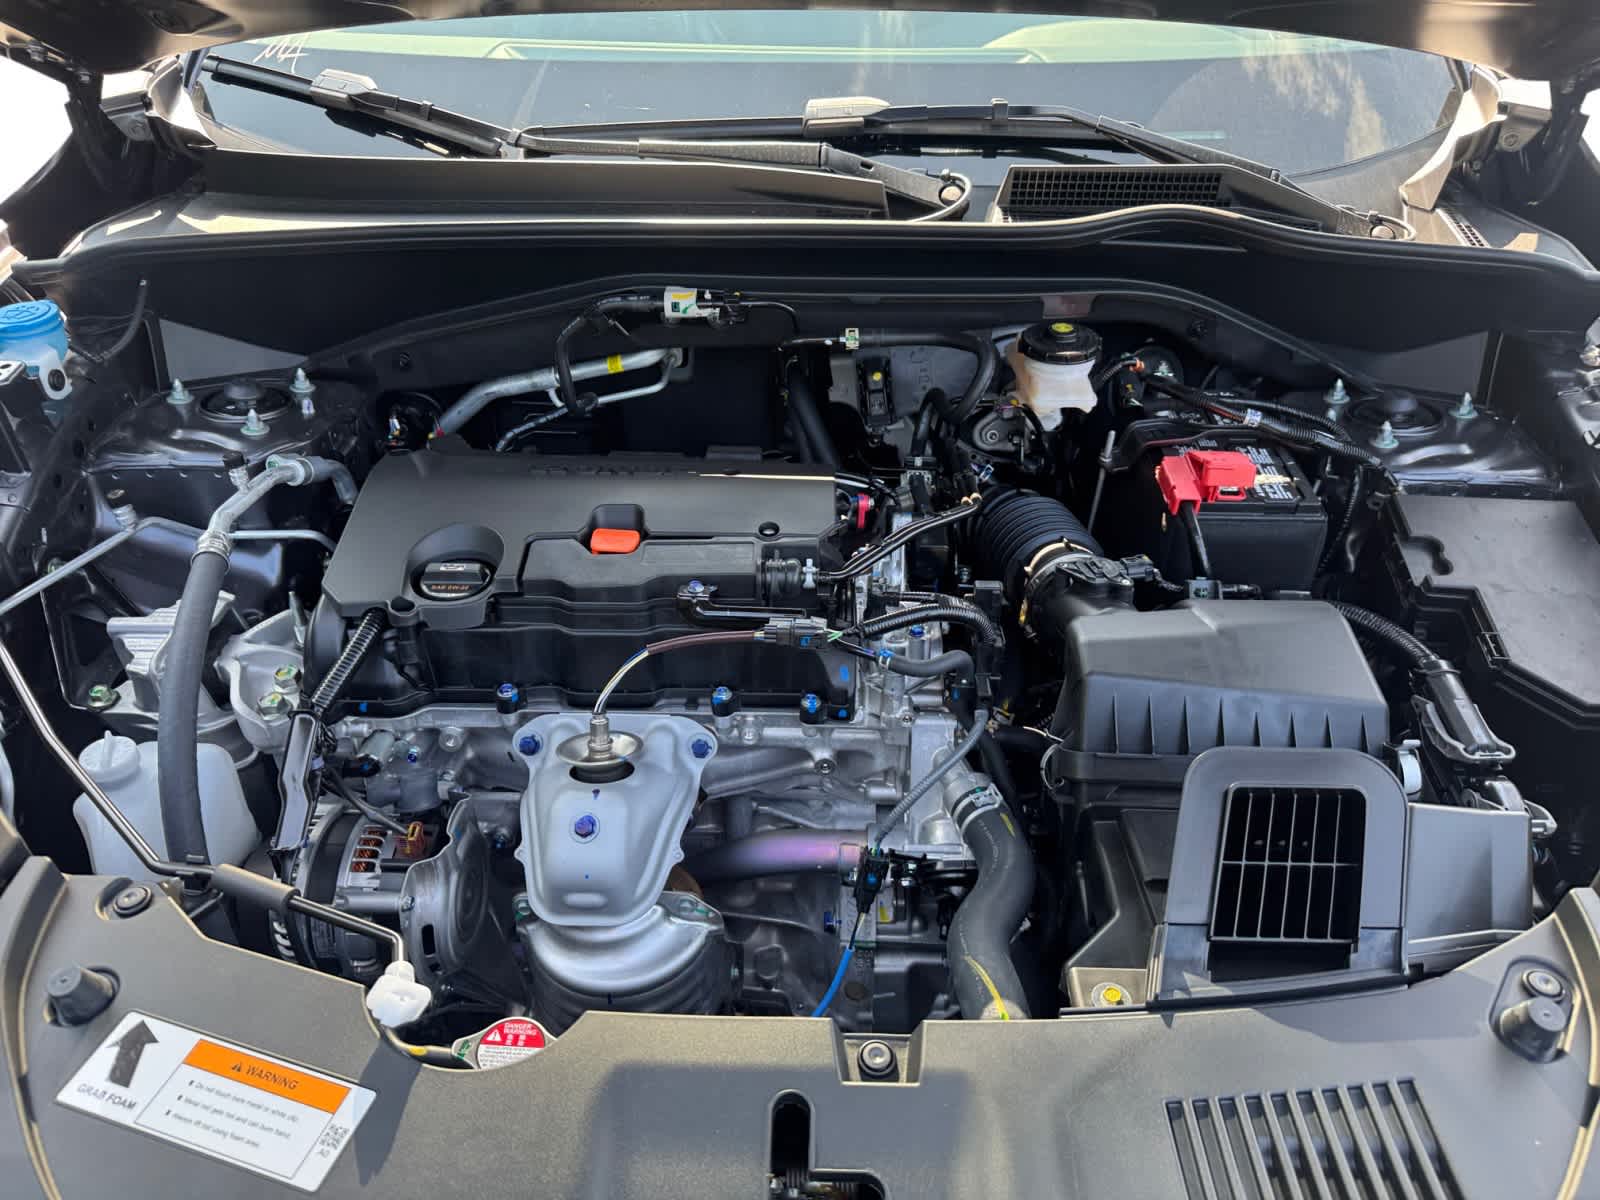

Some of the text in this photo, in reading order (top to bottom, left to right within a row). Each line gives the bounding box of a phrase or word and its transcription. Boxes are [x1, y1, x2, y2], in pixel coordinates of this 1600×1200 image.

[504, 1022, 533, 1030] DANGER
[246, 1064, 299, 1090] WARNING
[77, 1083, 137, 1110] GRAB FOAM
